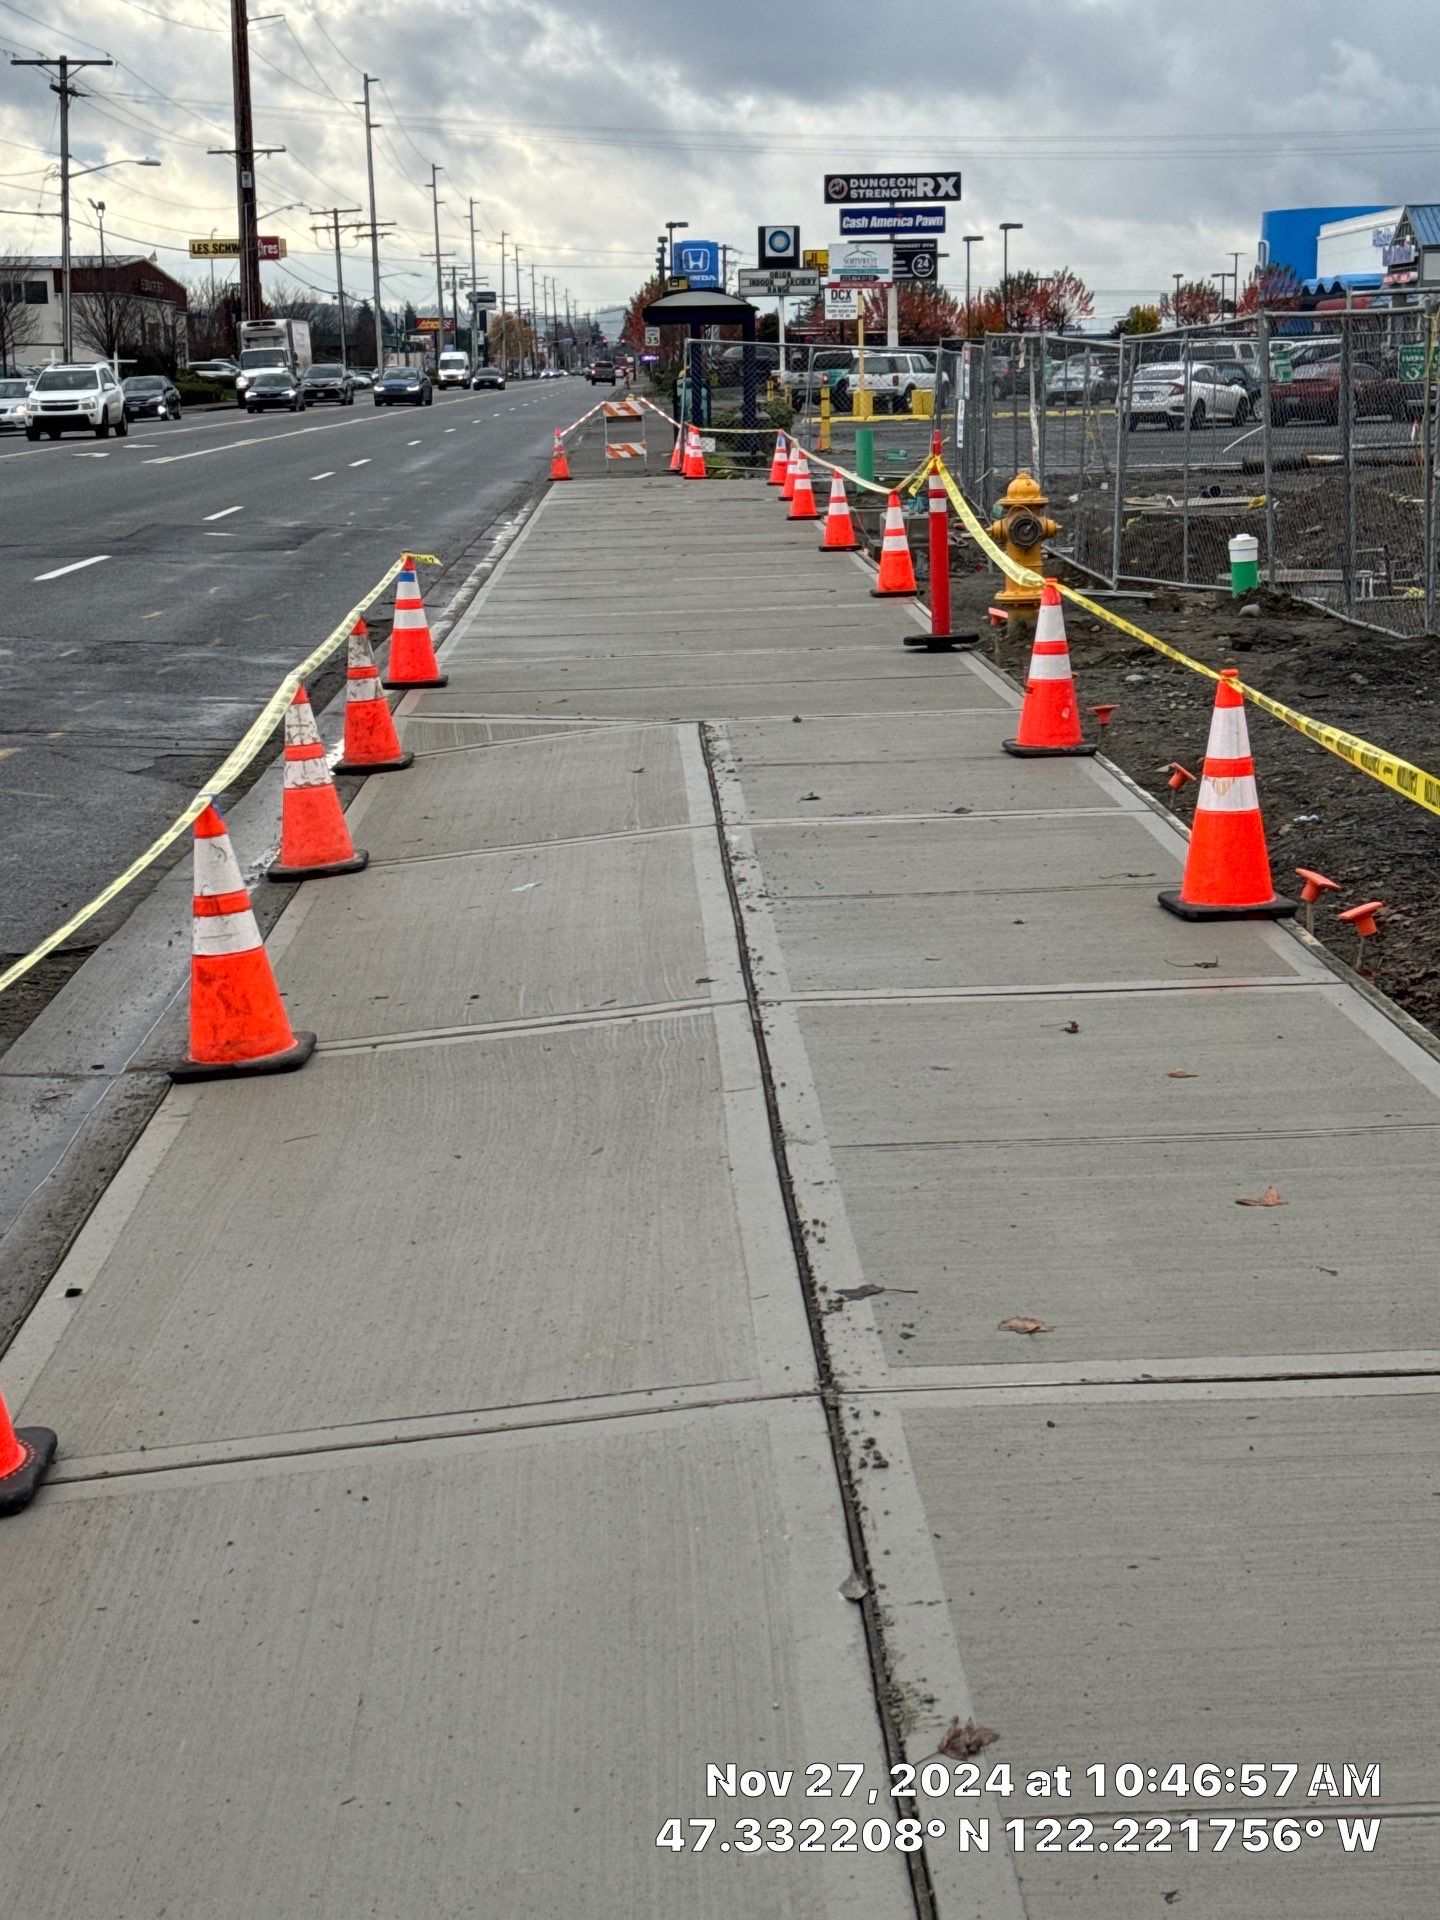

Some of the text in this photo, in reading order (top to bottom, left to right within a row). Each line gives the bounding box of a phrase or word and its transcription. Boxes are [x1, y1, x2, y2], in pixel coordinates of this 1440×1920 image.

[850, 178, 916, 188] DUNGEON
[916, 176, 958, 197] RX
[850, 188, 916, 198] STRENGTH
[842, 214, 943, 228] Cash America Pawn
[192, 243, 240, 254] LES SCHW
[916, 258, 929, 268] 24
[786, 278, 817, 286] ARCHERY
[831, 290, 852, 300] DCX
